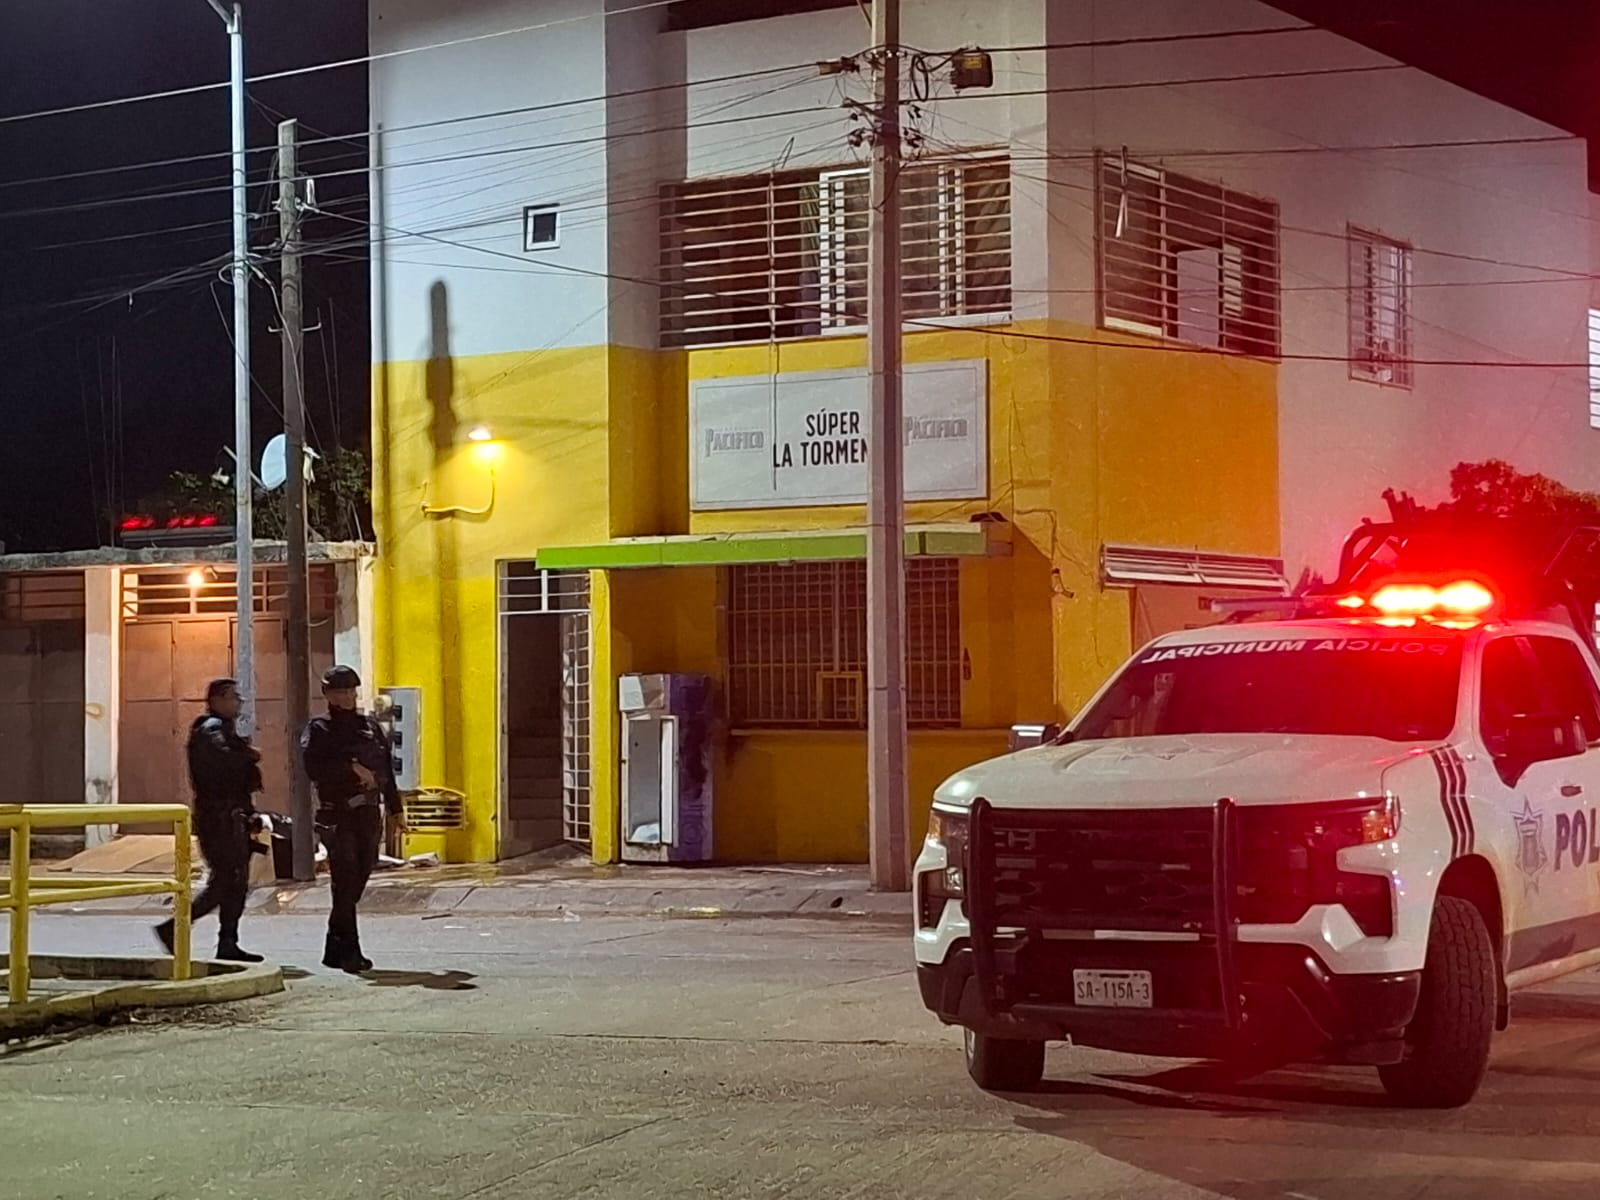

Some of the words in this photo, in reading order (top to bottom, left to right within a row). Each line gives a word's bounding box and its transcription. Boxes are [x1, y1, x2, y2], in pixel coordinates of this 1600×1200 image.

[806, 408, 860, 437] SÚPER
[773, 443, 792, 468] LA
[1554, 807, 1600, 872] POL
[1077, 981, 1149, 1000] SA-115A-3
